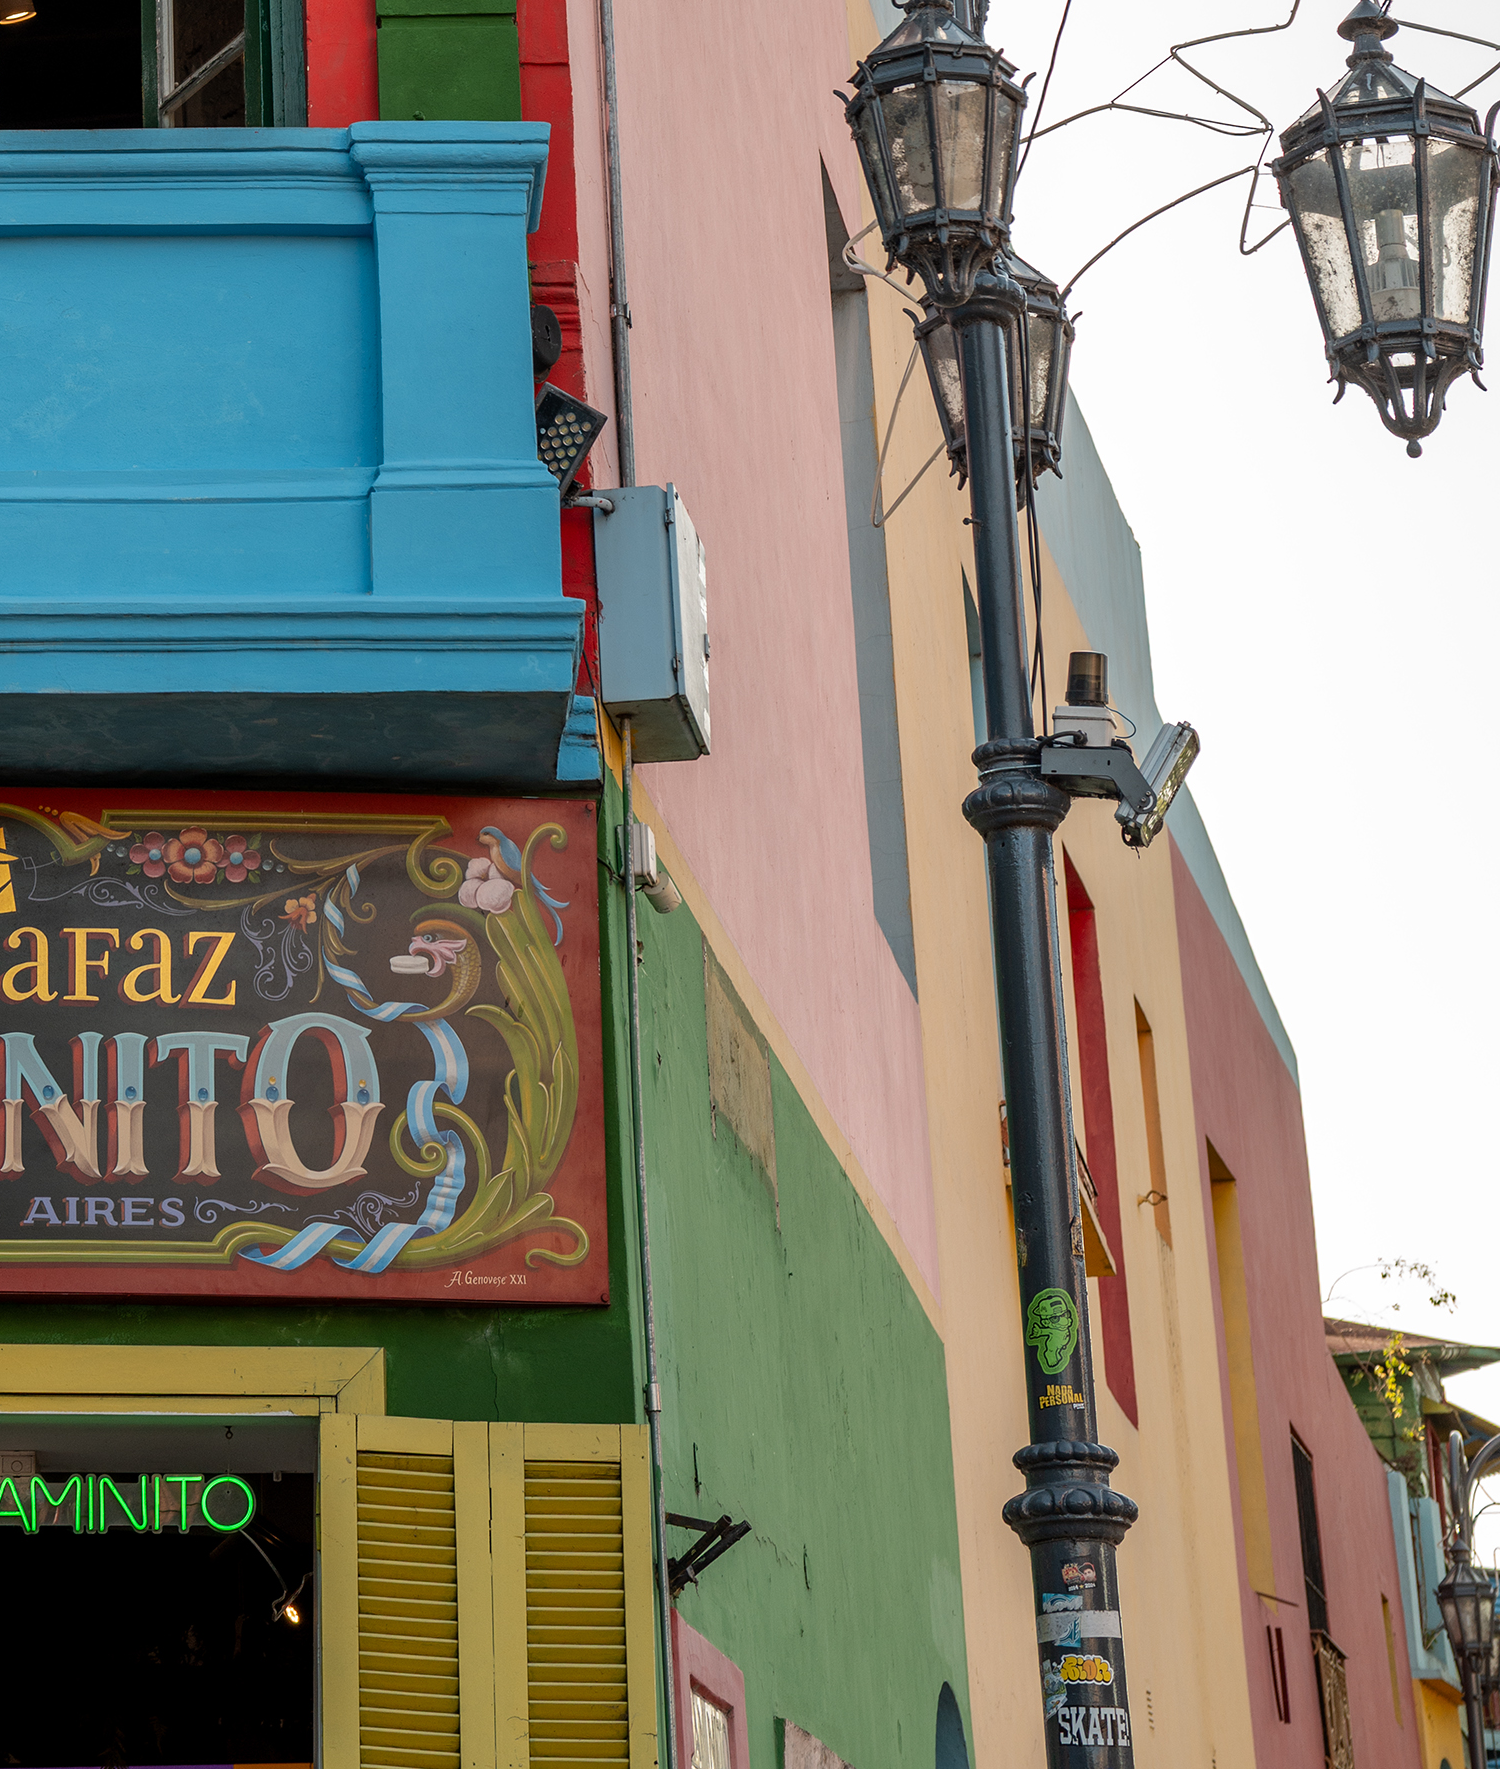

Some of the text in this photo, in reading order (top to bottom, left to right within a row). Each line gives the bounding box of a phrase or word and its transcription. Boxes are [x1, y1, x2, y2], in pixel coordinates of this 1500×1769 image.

[22, 1194, 186, 1228] AIRES
[464, 1270, 507, 1288] Genovese
[509, 1274, 527, 1285] XXI
[1046, 1384, 1074, 1396] NADA
[1039, 1392, 1084, 1409] PERSONAL
